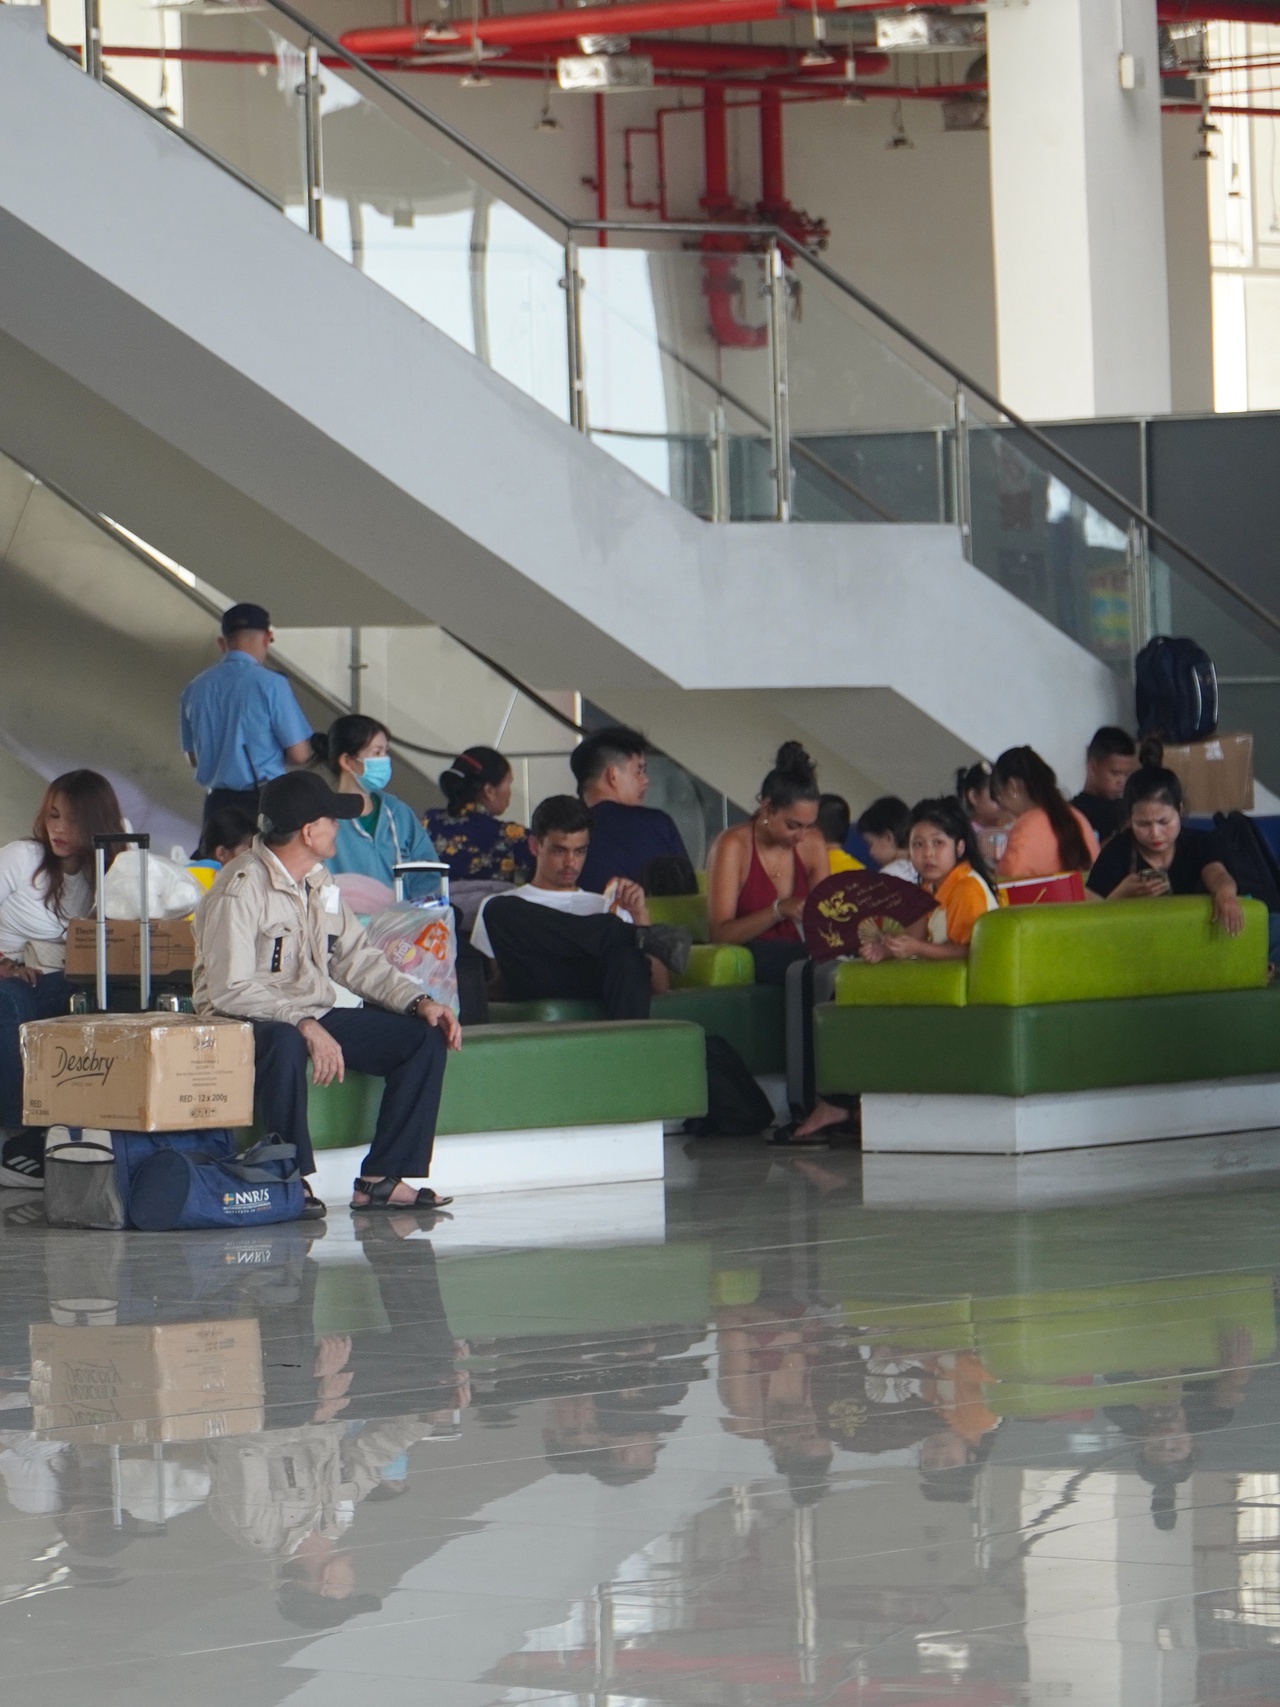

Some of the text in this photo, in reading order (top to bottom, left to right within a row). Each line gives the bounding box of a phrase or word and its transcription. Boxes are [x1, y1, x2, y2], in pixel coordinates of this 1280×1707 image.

[76, 927, 97, 935] Electri
[179, 1095, 192, 1103] RED
[198, 1094, 206, 1102] 12
[212, 1094, 227, 1103] 200g
[30, 1100, 42, 1108] RED
